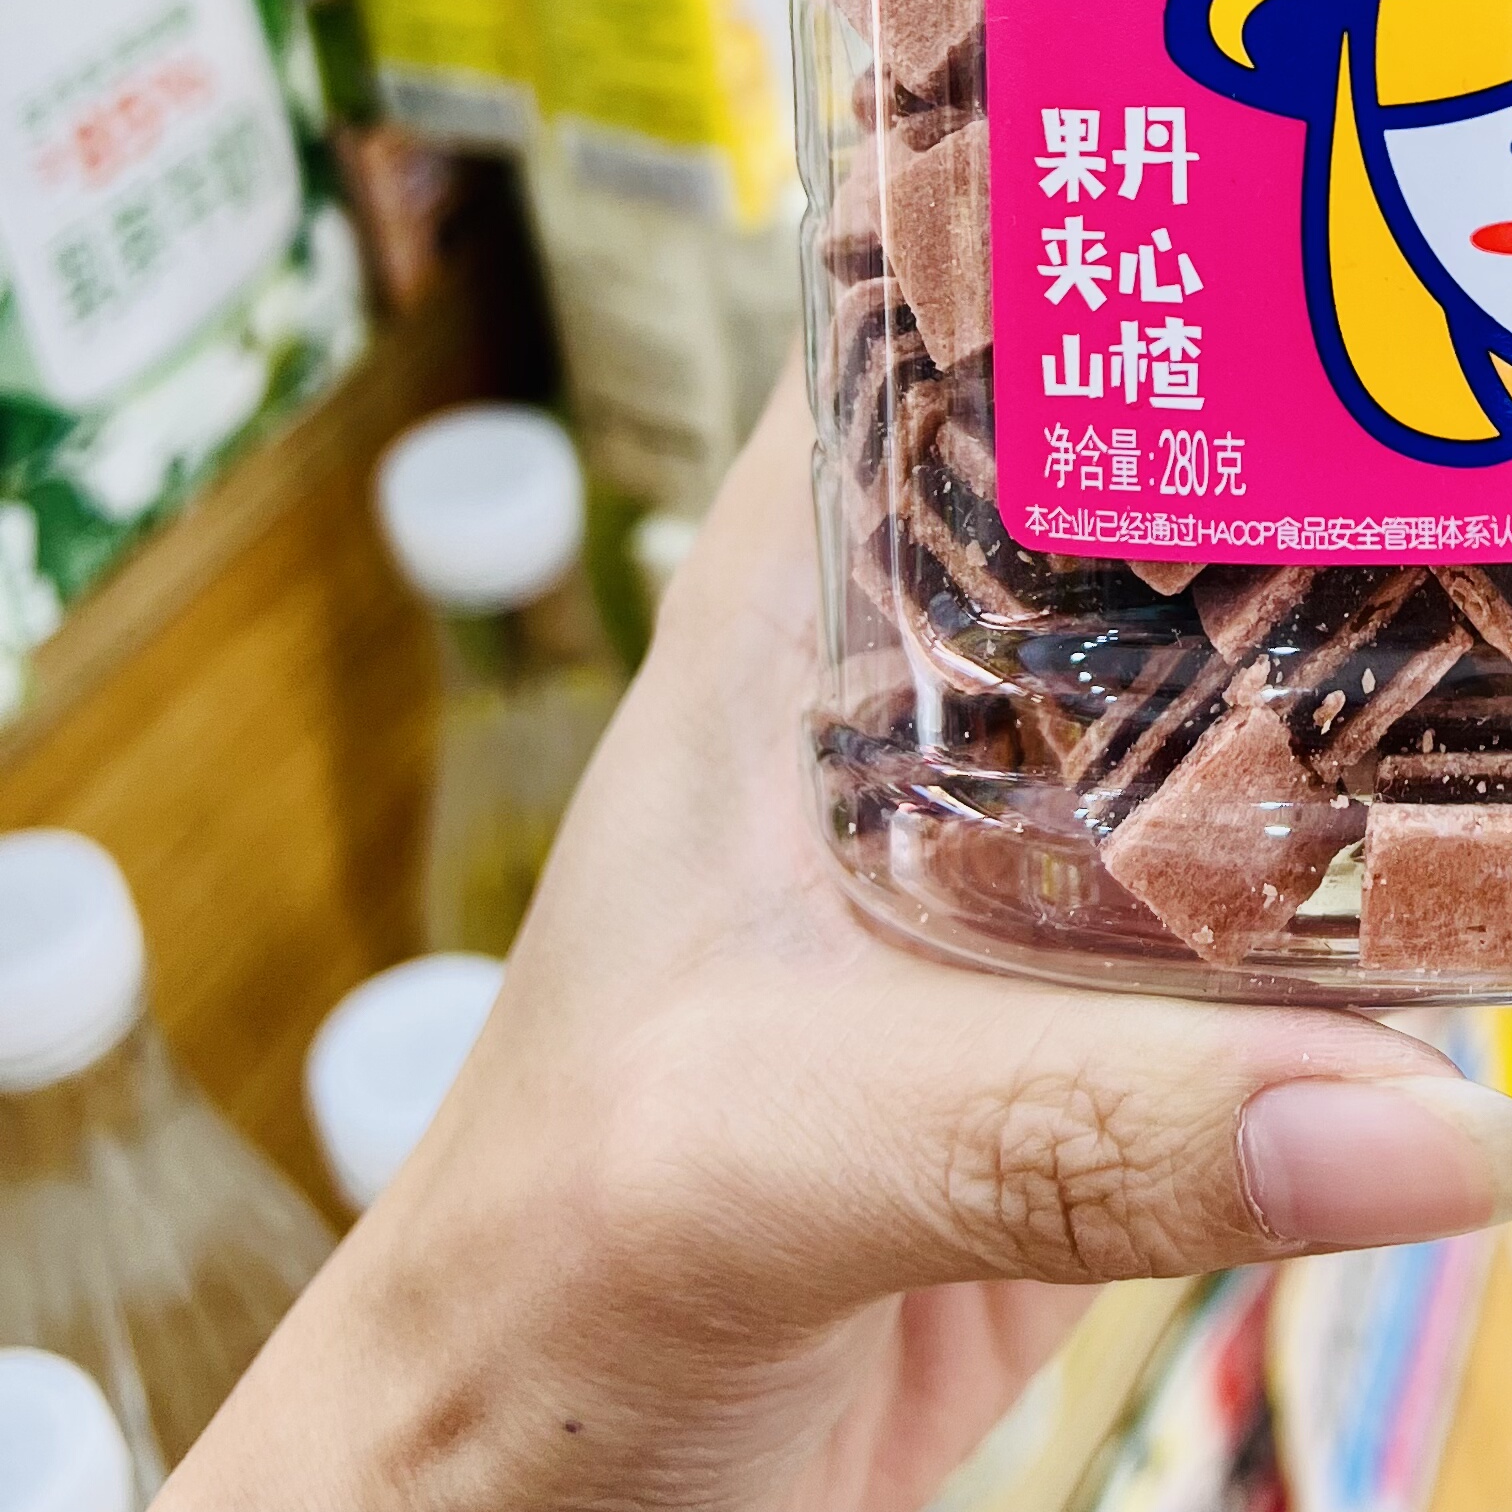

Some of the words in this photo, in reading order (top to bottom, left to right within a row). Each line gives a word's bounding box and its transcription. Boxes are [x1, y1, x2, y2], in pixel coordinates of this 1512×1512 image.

[1034, 106, 1200, 205] 果丹
[1037, 214, 1204, 311] 夹心
[1041, 316, 1205, 410] 山楂
